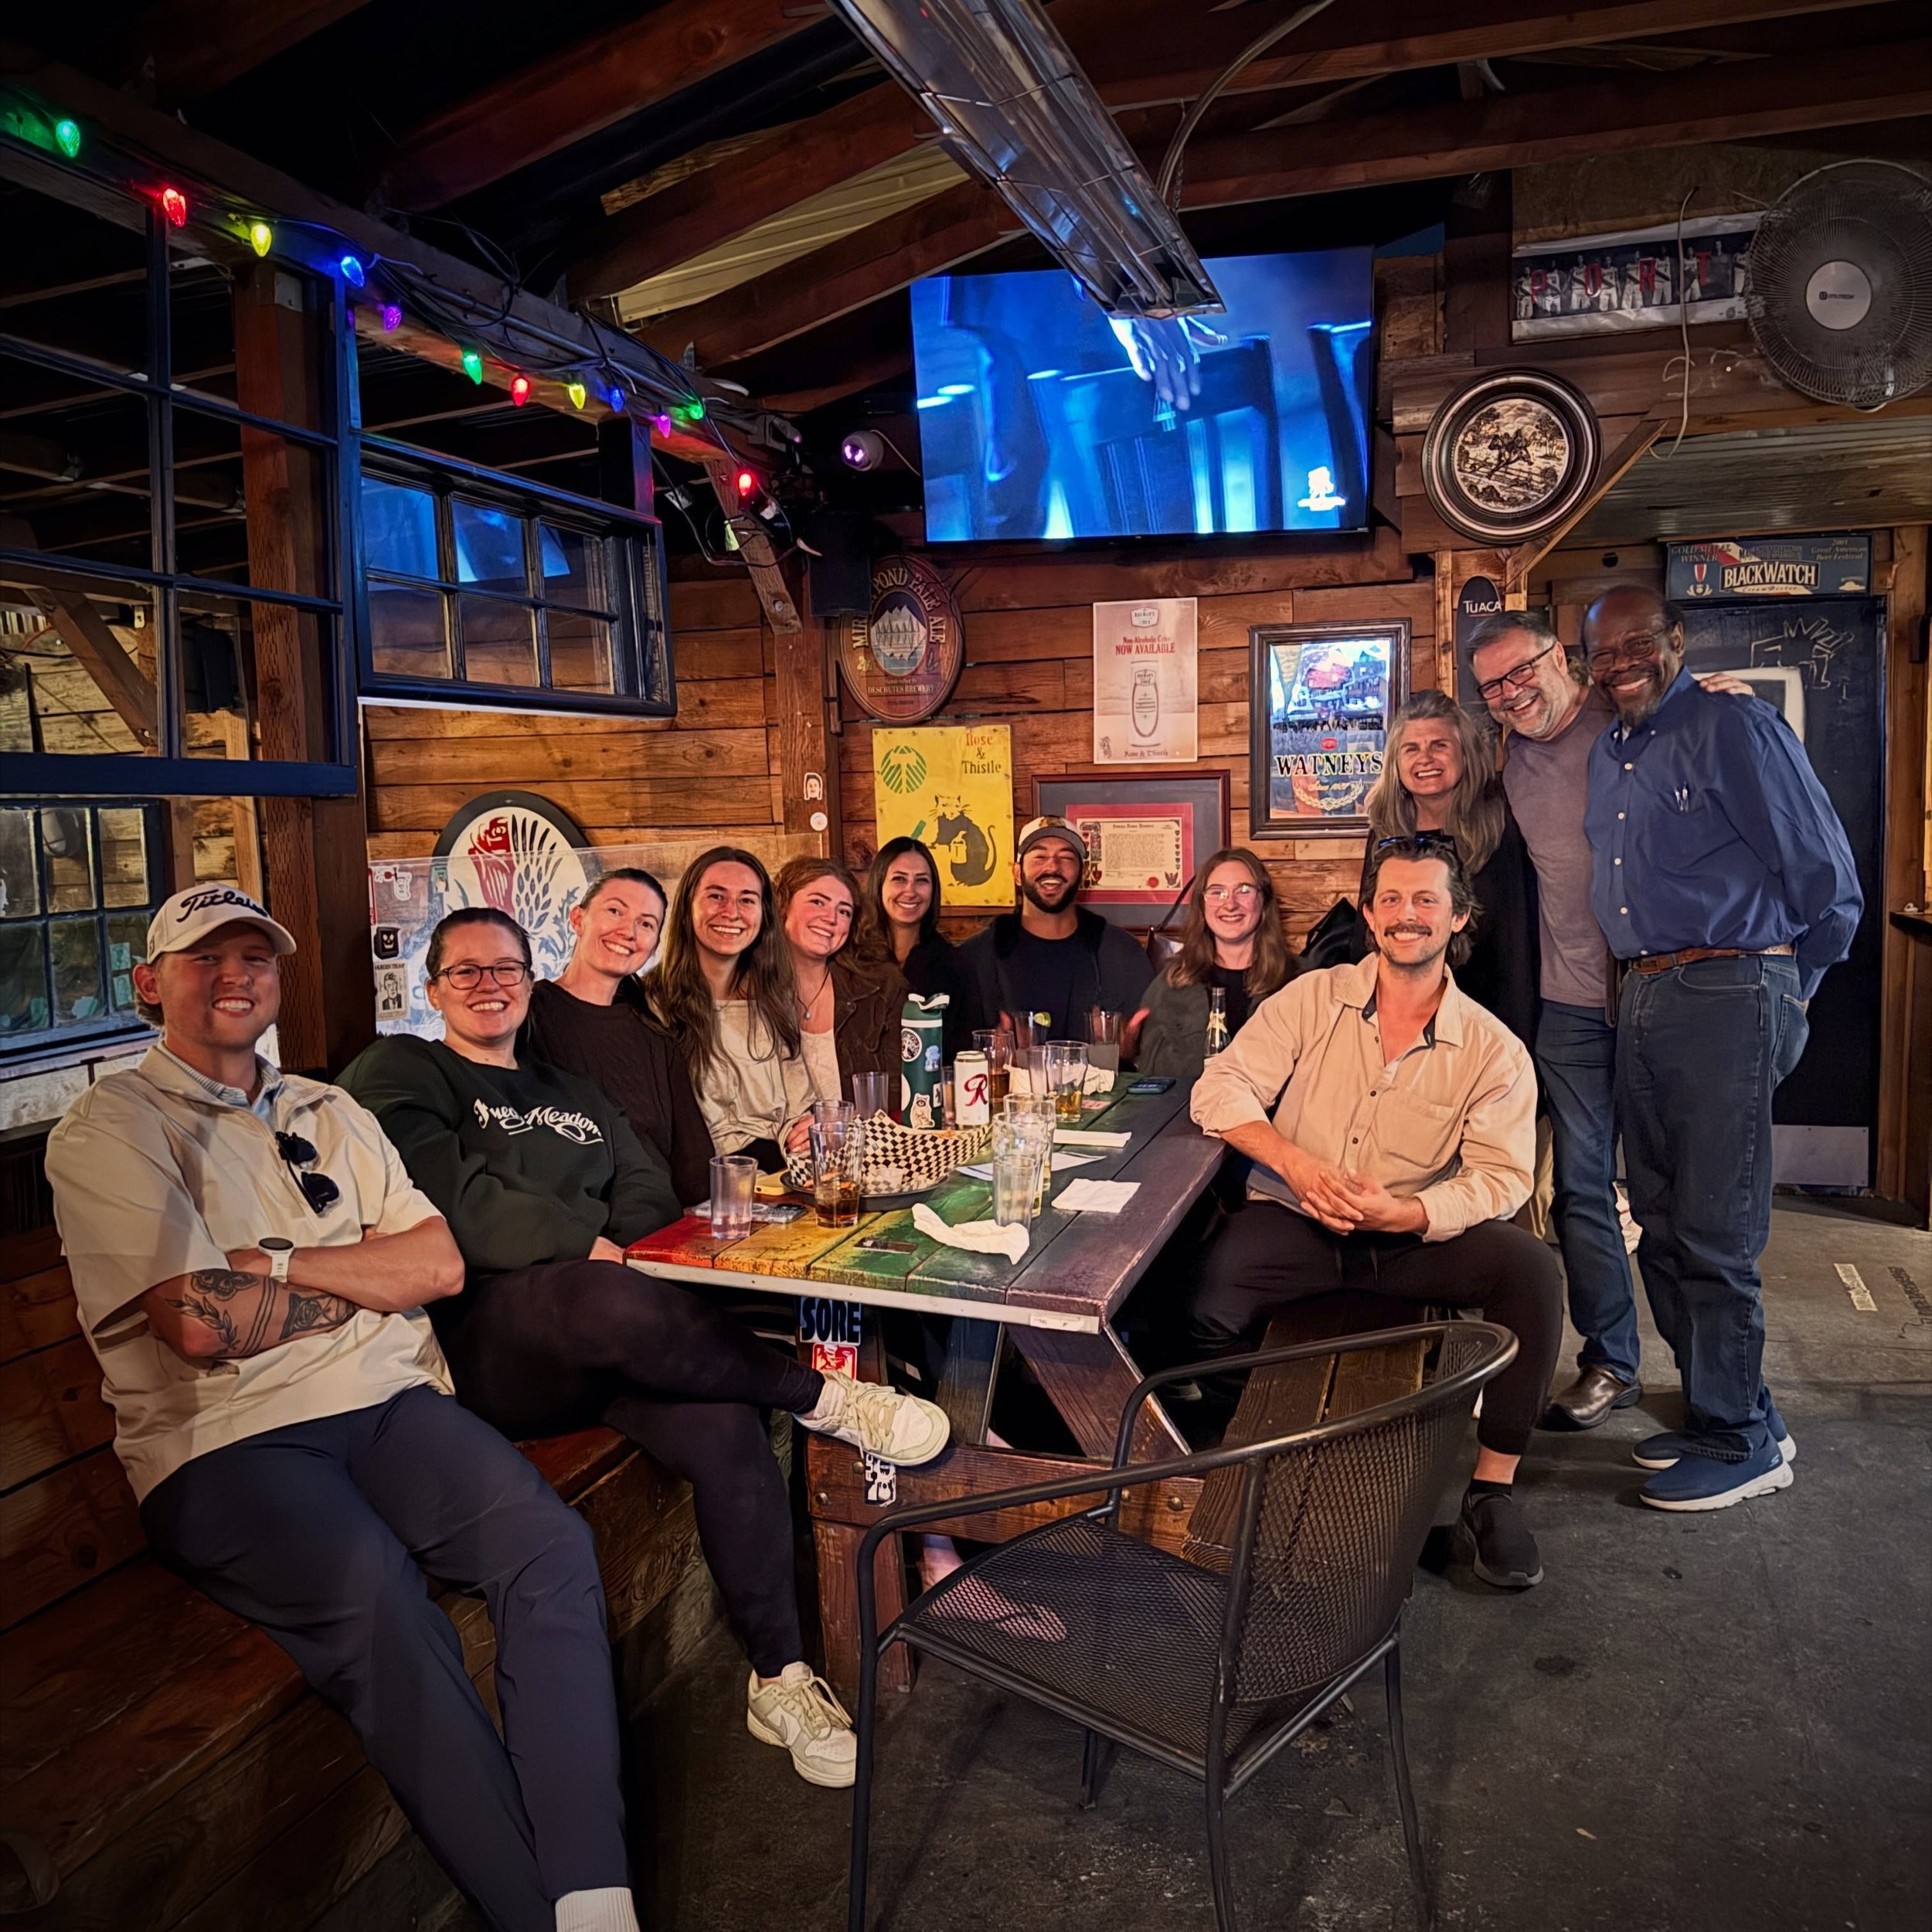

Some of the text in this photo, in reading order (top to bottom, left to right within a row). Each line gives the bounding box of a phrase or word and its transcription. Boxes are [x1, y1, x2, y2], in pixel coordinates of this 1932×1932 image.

[1681, 553, 1718, 563] WINNER
[907, 573, 941, 611] PALE
[928, 616, 947, 644] ALE
[1115, 642, 1175, 655] NOW AVAILABLE
[868, 684, 934, 694] DESCHUTES BREWERY
[966, 733, 994, 747] Rose
[976, 747, 986, 760] &
[961, 760, 1002, 774] Thistle
[1274, 750, 1384, 777] WATNEYS
[964, 1073, 988, 1107] R
[801, 1298, 862, 1344] SORE
